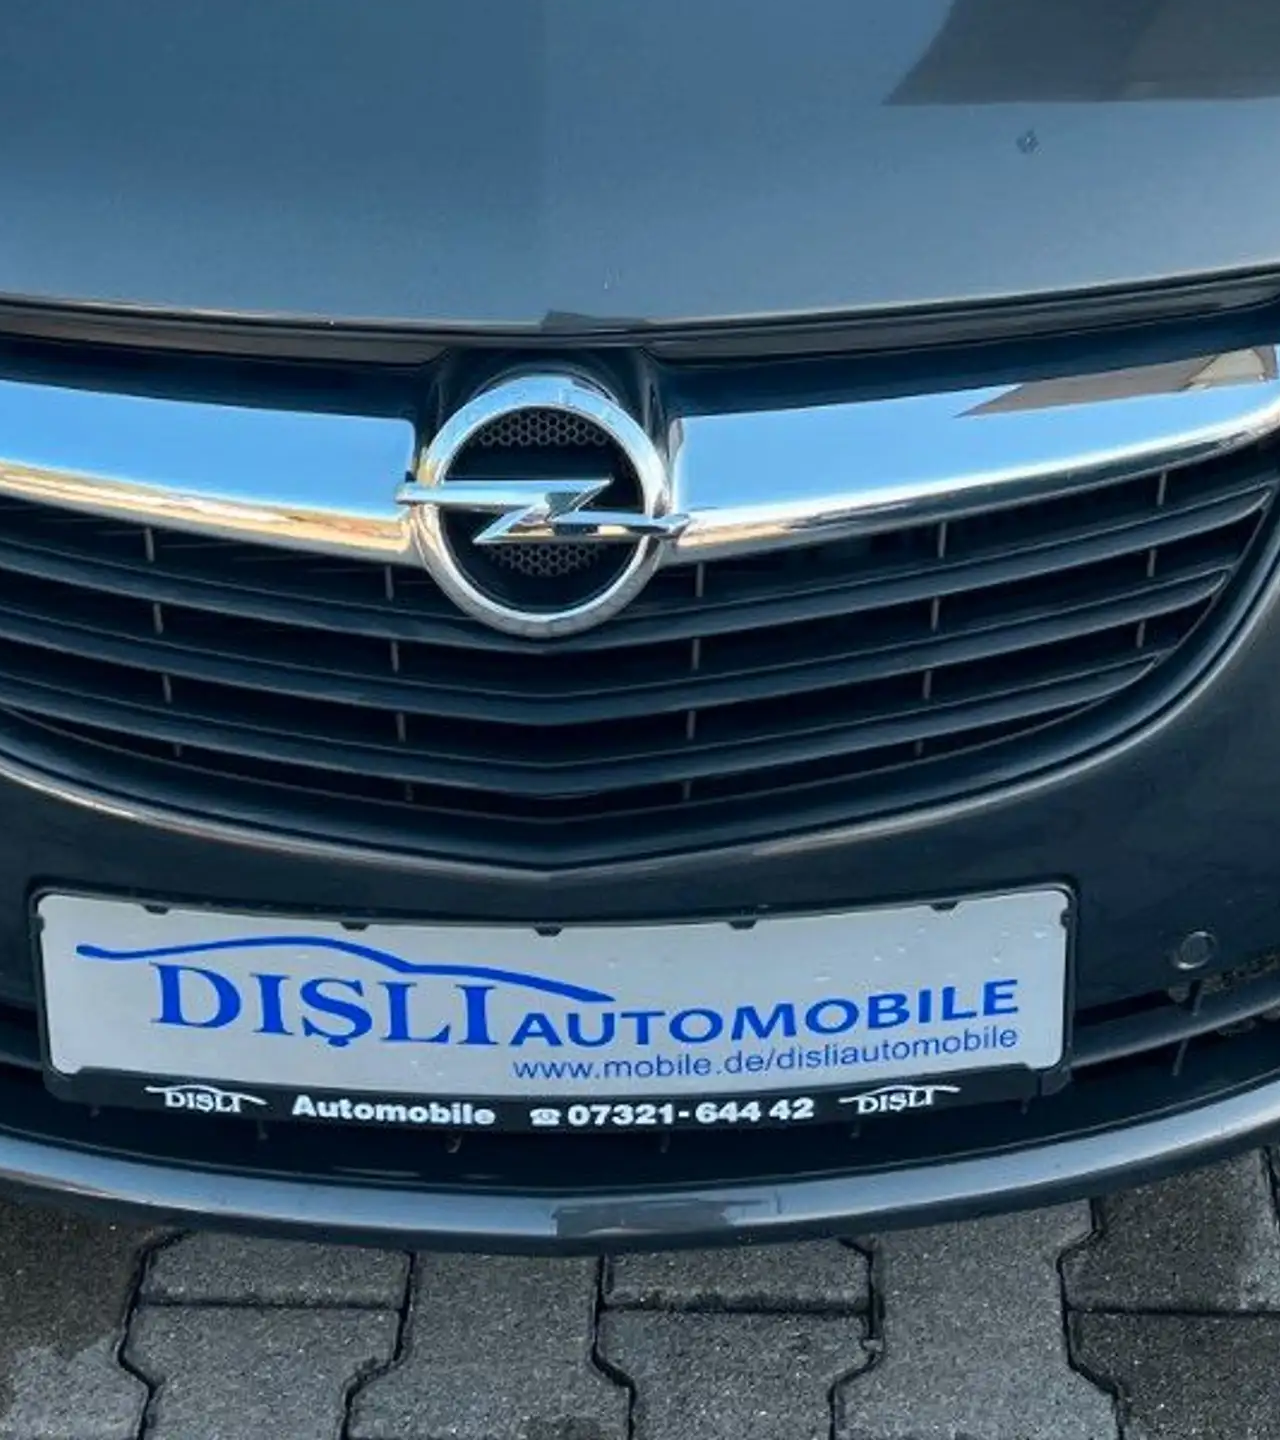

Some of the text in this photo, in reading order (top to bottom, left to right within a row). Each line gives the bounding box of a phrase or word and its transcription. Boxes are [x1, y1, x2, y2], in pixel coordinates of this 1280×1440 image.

[150, 962, 1018, 1047] DIŞLI AUTOMOBILE
[512, 1026, 1018, 1079] www.mobile.de/disliautomobile
[292, 1094, 496, 1126] Automobile
